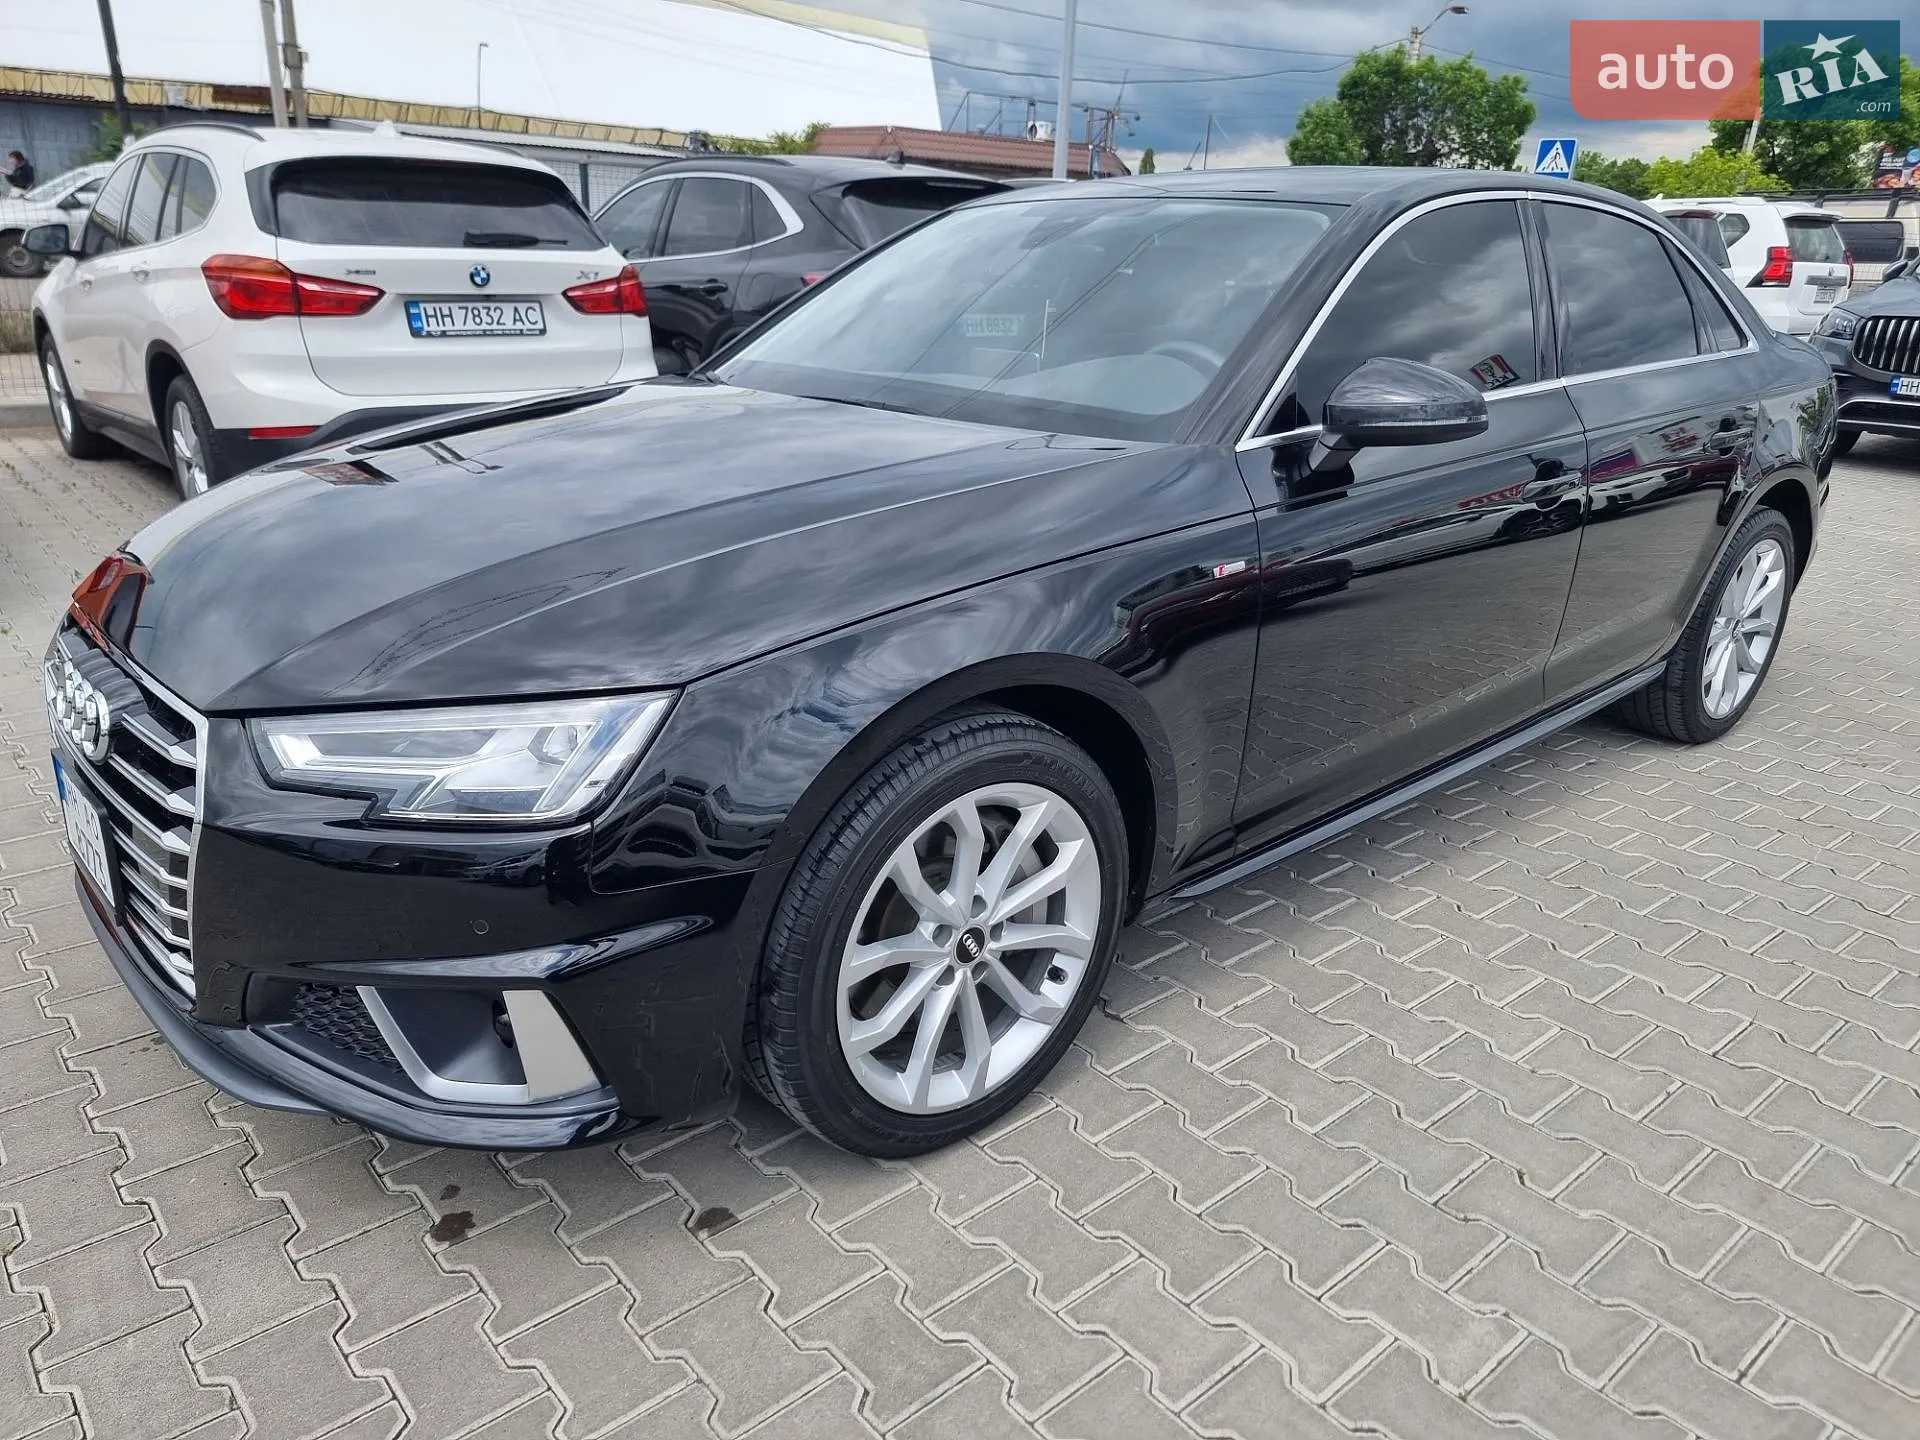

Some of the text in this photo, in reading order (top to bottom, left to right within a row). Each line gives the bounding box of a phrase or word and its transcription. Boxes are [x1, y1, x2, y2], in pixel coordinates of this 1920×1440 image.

[423, 306, 538, 327] HH 7832 AC
